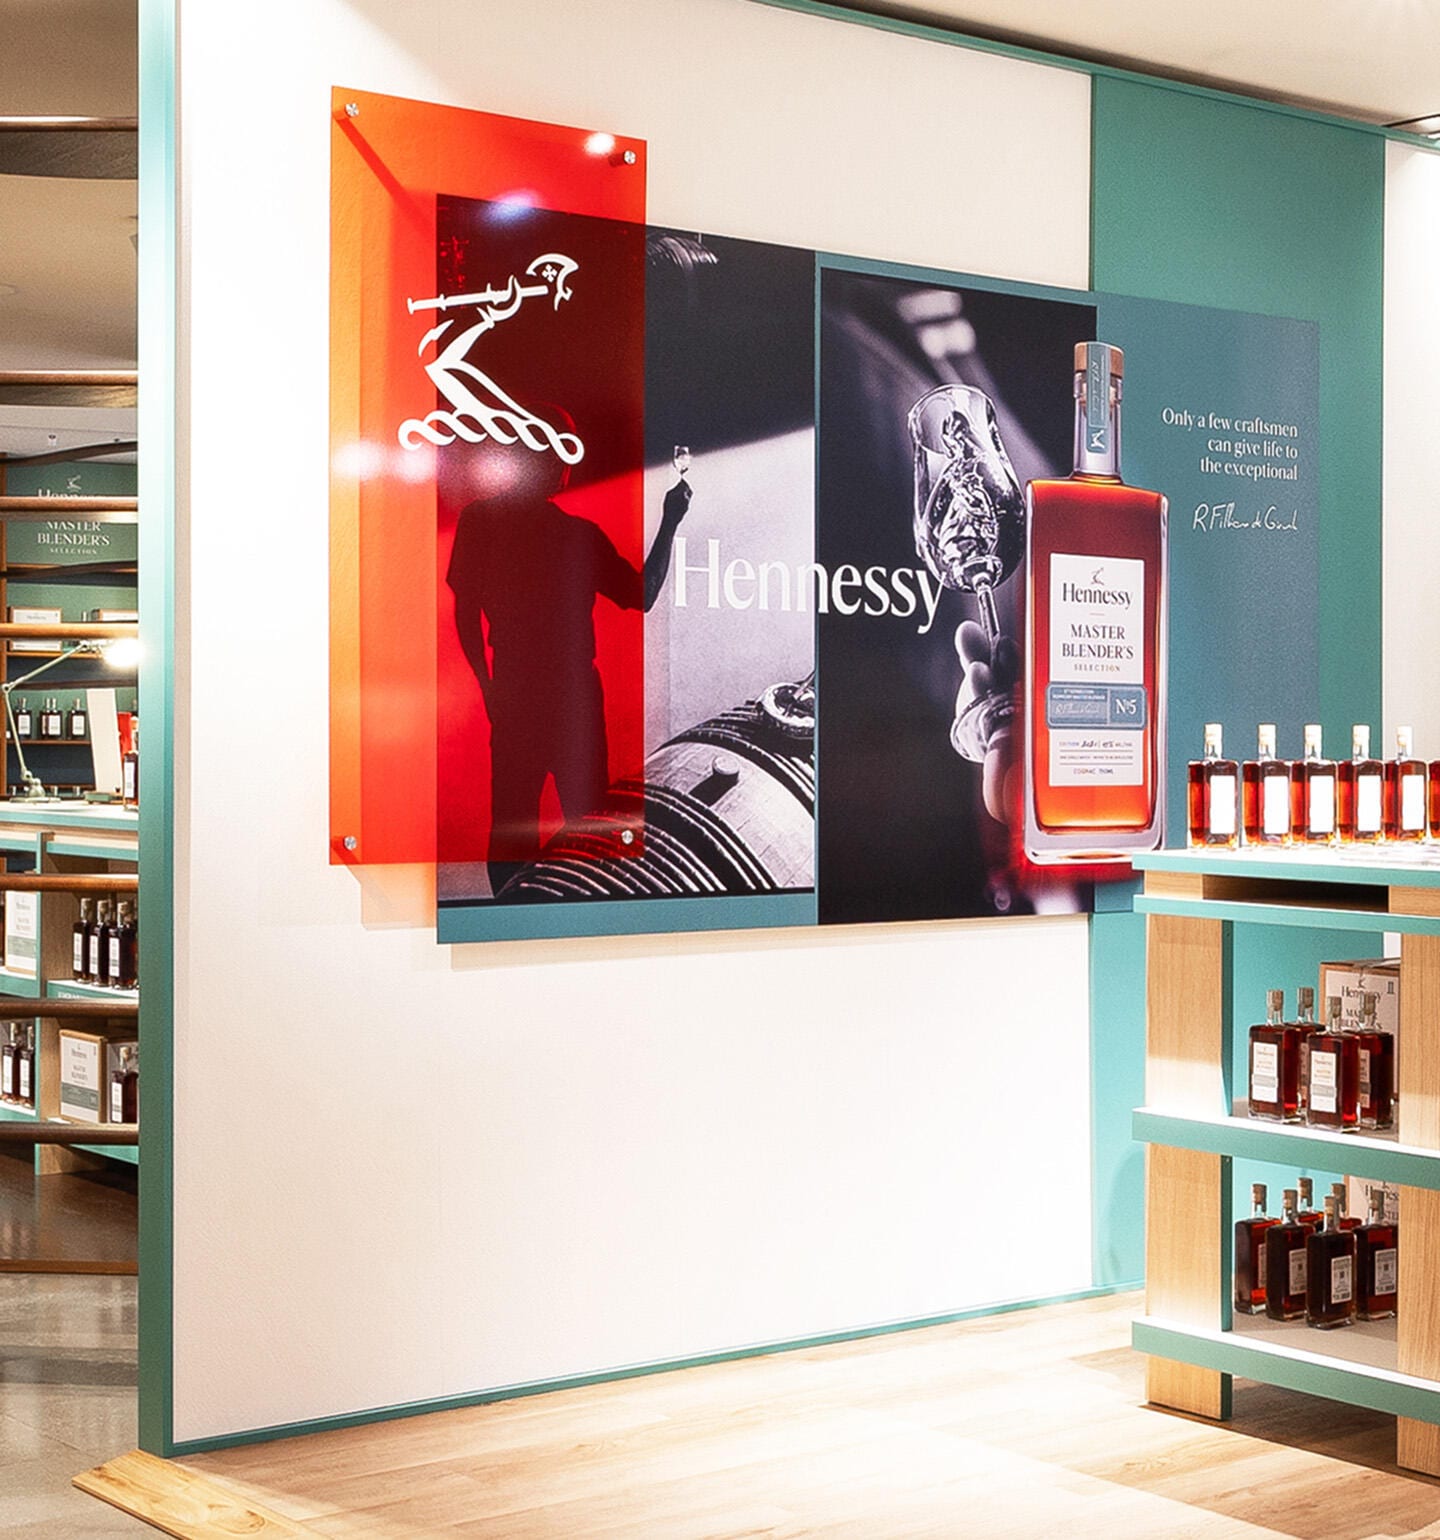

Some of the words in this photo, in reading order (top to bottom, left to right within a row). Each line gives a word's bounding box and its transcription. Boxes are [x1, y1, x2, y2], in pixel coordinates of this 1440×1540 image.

[1162, 407, 1195, 431] Only
[1197, 416, 1206, 428] a
[1208, 412, 1232, 430] few
[1234, 417, 1298, 437] craftsmen
[1208, 438, 1231, 453] can
[1234, 439, 1260, 458] give
[1263, 440, 1283, 457] life
[1285, 445, 1298, 459] to
[1200, 456, 1222, 473] the
[1224, 463, 1298, 481] exceptional
[46, 520, 102, 532] MASTER
[674, 537, 947, 634] Hennessy
[1062, 582, 1133, 610] Hennessy
[1071, 623, 1125, 640] MASTER
[1062, 643, 1134, 660] BLENDER'S
[1074, 663, 1121, 672] SELECTION
